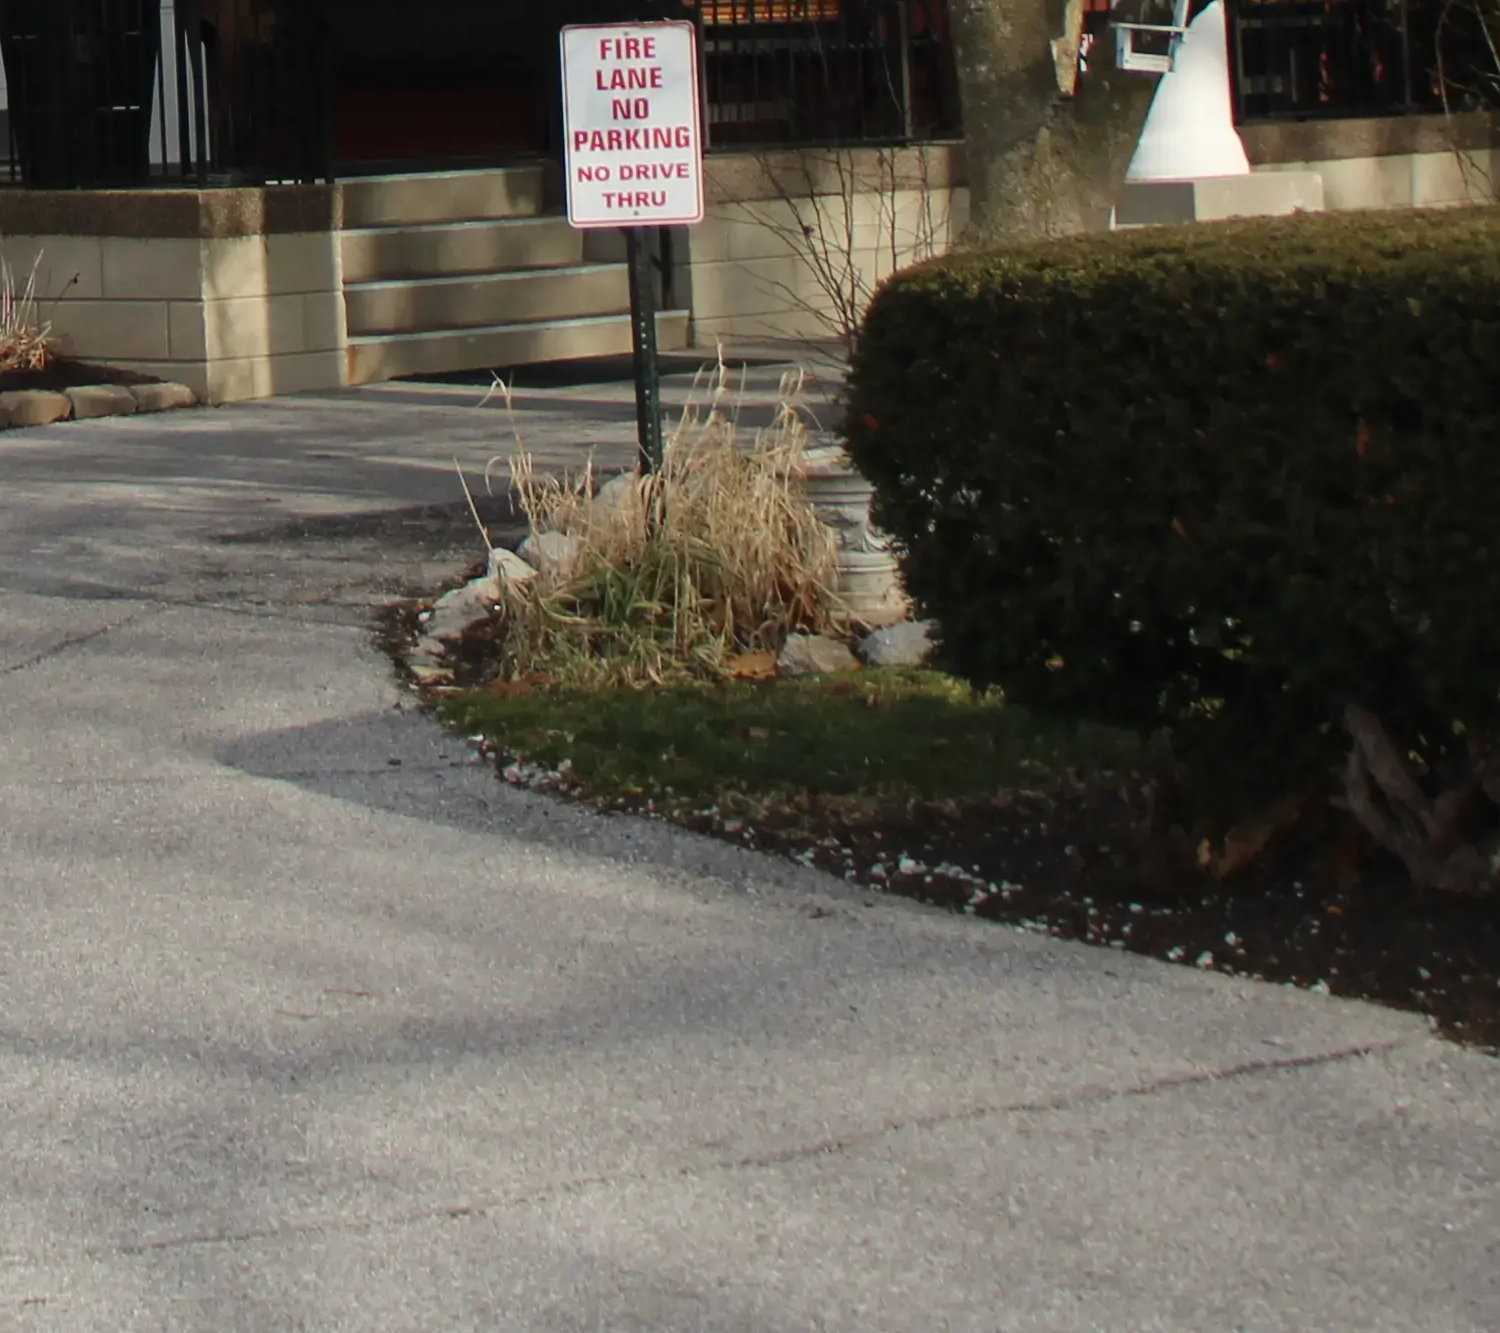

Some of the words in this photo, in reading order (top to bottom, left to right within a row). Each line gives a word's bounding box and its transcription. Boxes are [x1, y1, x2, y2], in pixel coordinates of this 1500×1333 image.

[600, 37, 656, 60] FIRE
[596, 67, 663, 91] LANE
[612, 97, 649, 120] NO
[574, 126, 690, 152] PARKING
[577, 166, 610, 182] NO
[619, 163, 690, 180] DRIVE
[602, 191, 667, 208] THRU
